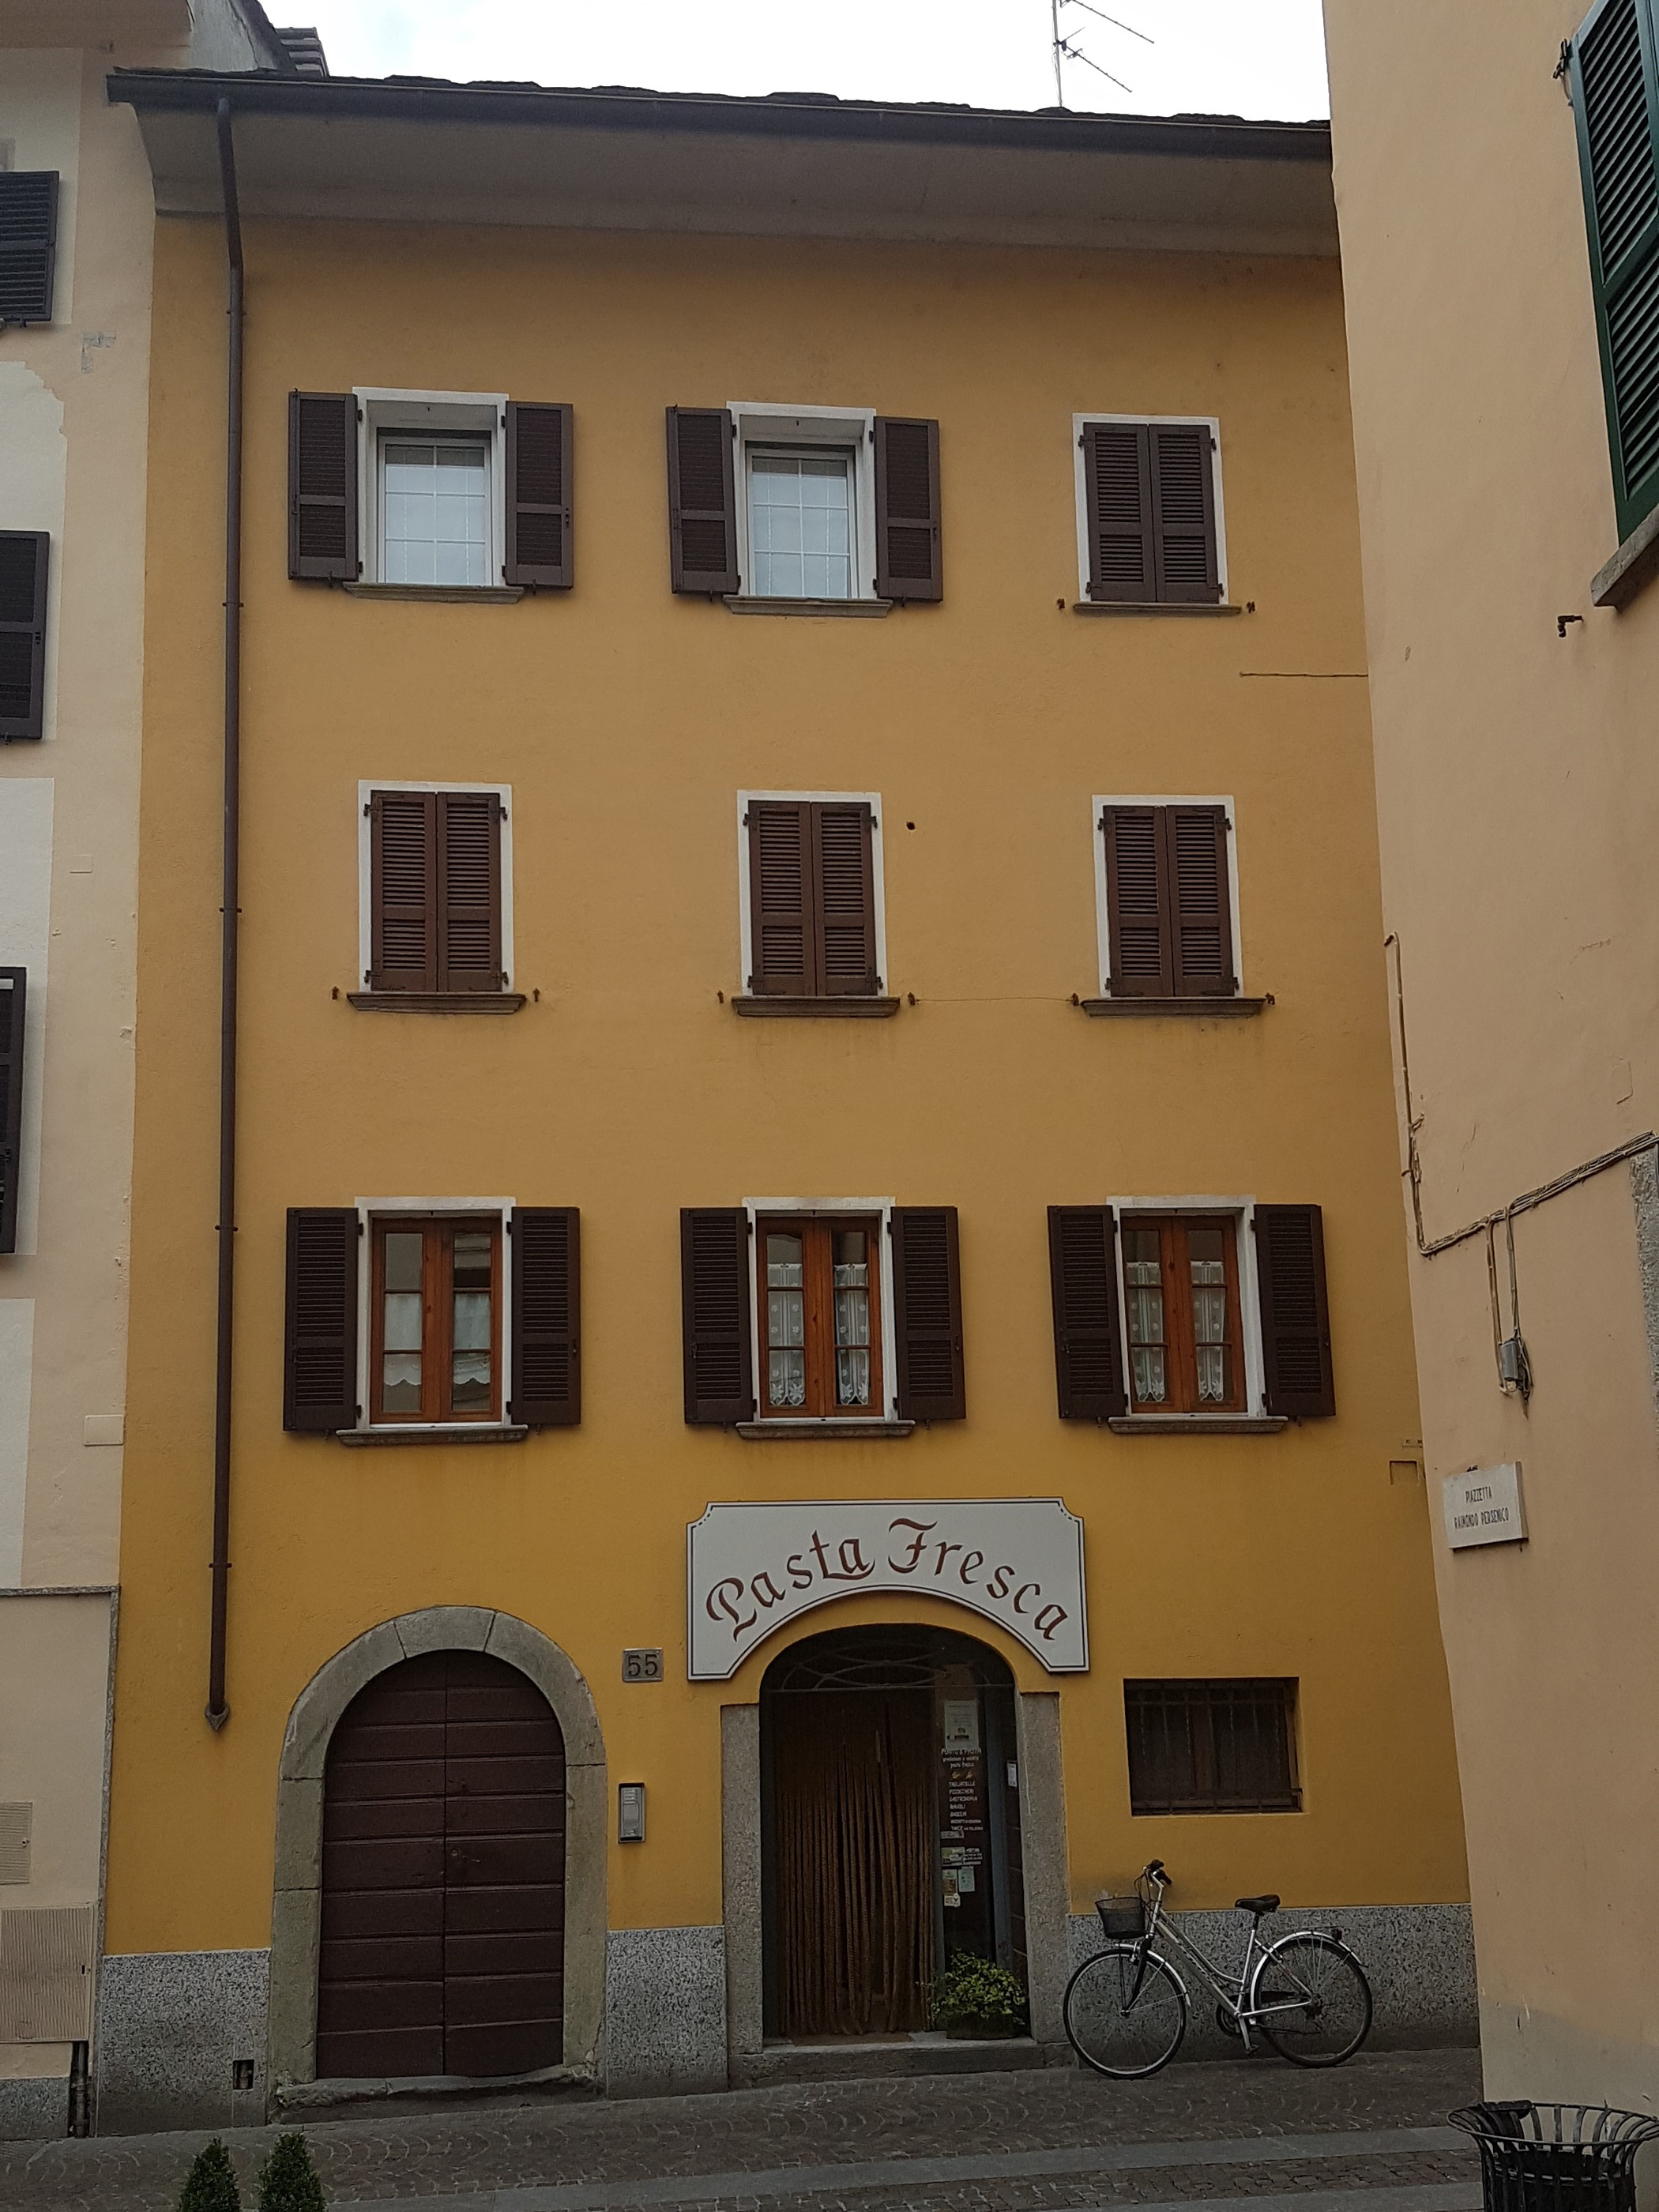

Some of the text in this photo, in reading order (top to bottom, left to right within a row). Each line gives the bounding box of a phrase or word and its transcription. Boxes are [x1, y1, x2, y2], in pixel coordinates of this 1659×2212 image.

[1465, 1486, 1492, 1503] PIAZZETTA
[1454, 1512, 1479, 1529] RAIMONDO
[706, 1518, 1068, 1642] Pasta Fresca
[628, 1653, 657, 1676] 55
